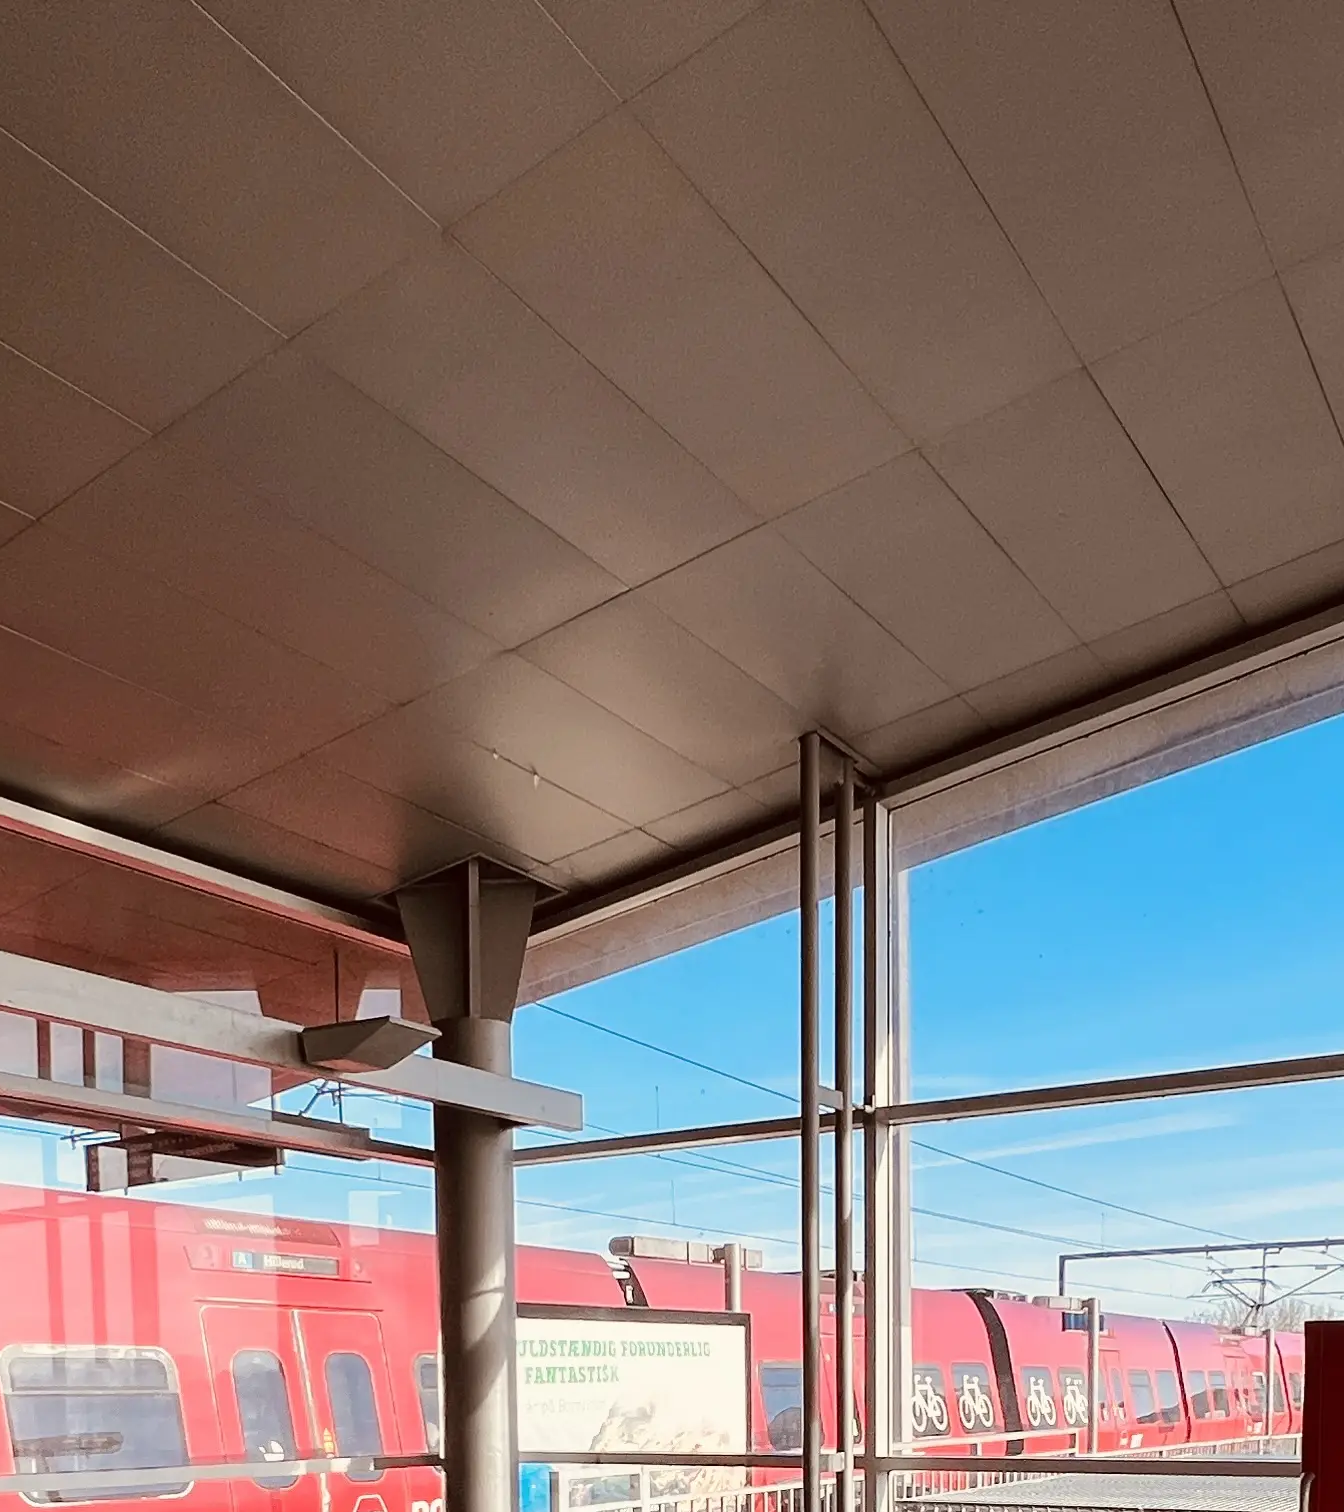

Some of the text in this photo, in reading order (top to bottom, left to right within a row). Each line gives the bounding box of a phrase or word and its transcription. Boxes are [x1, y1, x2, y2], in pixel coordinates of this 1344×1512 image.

[238, 1252, 247, 1265] A
[620, 1340, 711, 1357] FORUNDERLIG
[524, 1364, 620, 1384] FANTASTISK
